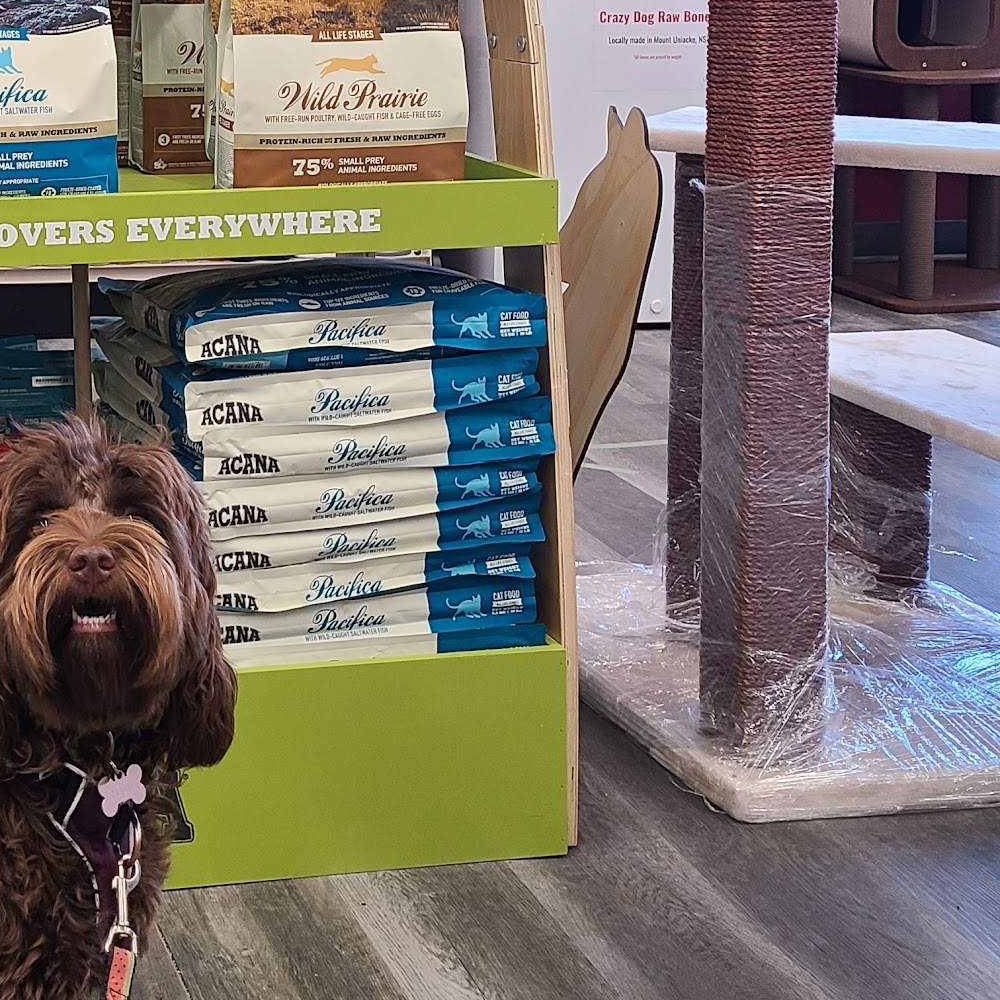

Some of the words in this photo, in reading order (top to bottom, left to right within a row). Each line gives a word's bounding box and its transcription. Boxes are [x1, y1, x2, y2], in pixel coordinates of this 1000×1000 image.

[600, 11, 630, 25] Crazy
[634, 11, 654, 25] Dog
[658, 11, 680, 22] Raw
[609, 36, 628, 45] Locally
[630, 36, 645, 44] made
[654, 36, 671, 44] Mount
[278, 81, 343, 111] Wild
[343, 79, 429, 111] Prairie
[5, 107, 38, 116] SALTWATER
[40, 106, 53, 114] FISH
[9, 130, 17, 138] &
[18, 129, 39, 137] RAW
[41, 126, 98, 136] INGREDIENTS
[12, 152, 33, 161] PREY
[16, 159, 68, 170] INGREDIENTS
[126, 208, 381, 242] EVERYWHERE
[201, 334, 262, 358] ACANA
[308, 318, 386, 344] Pacifica
[201, 401, 263, 426] ACANA
[310, 385, 390, 413] Pacifica
[208, 504, 268, 527] ACANA
[317, 483, 394, 514] Pacifica
